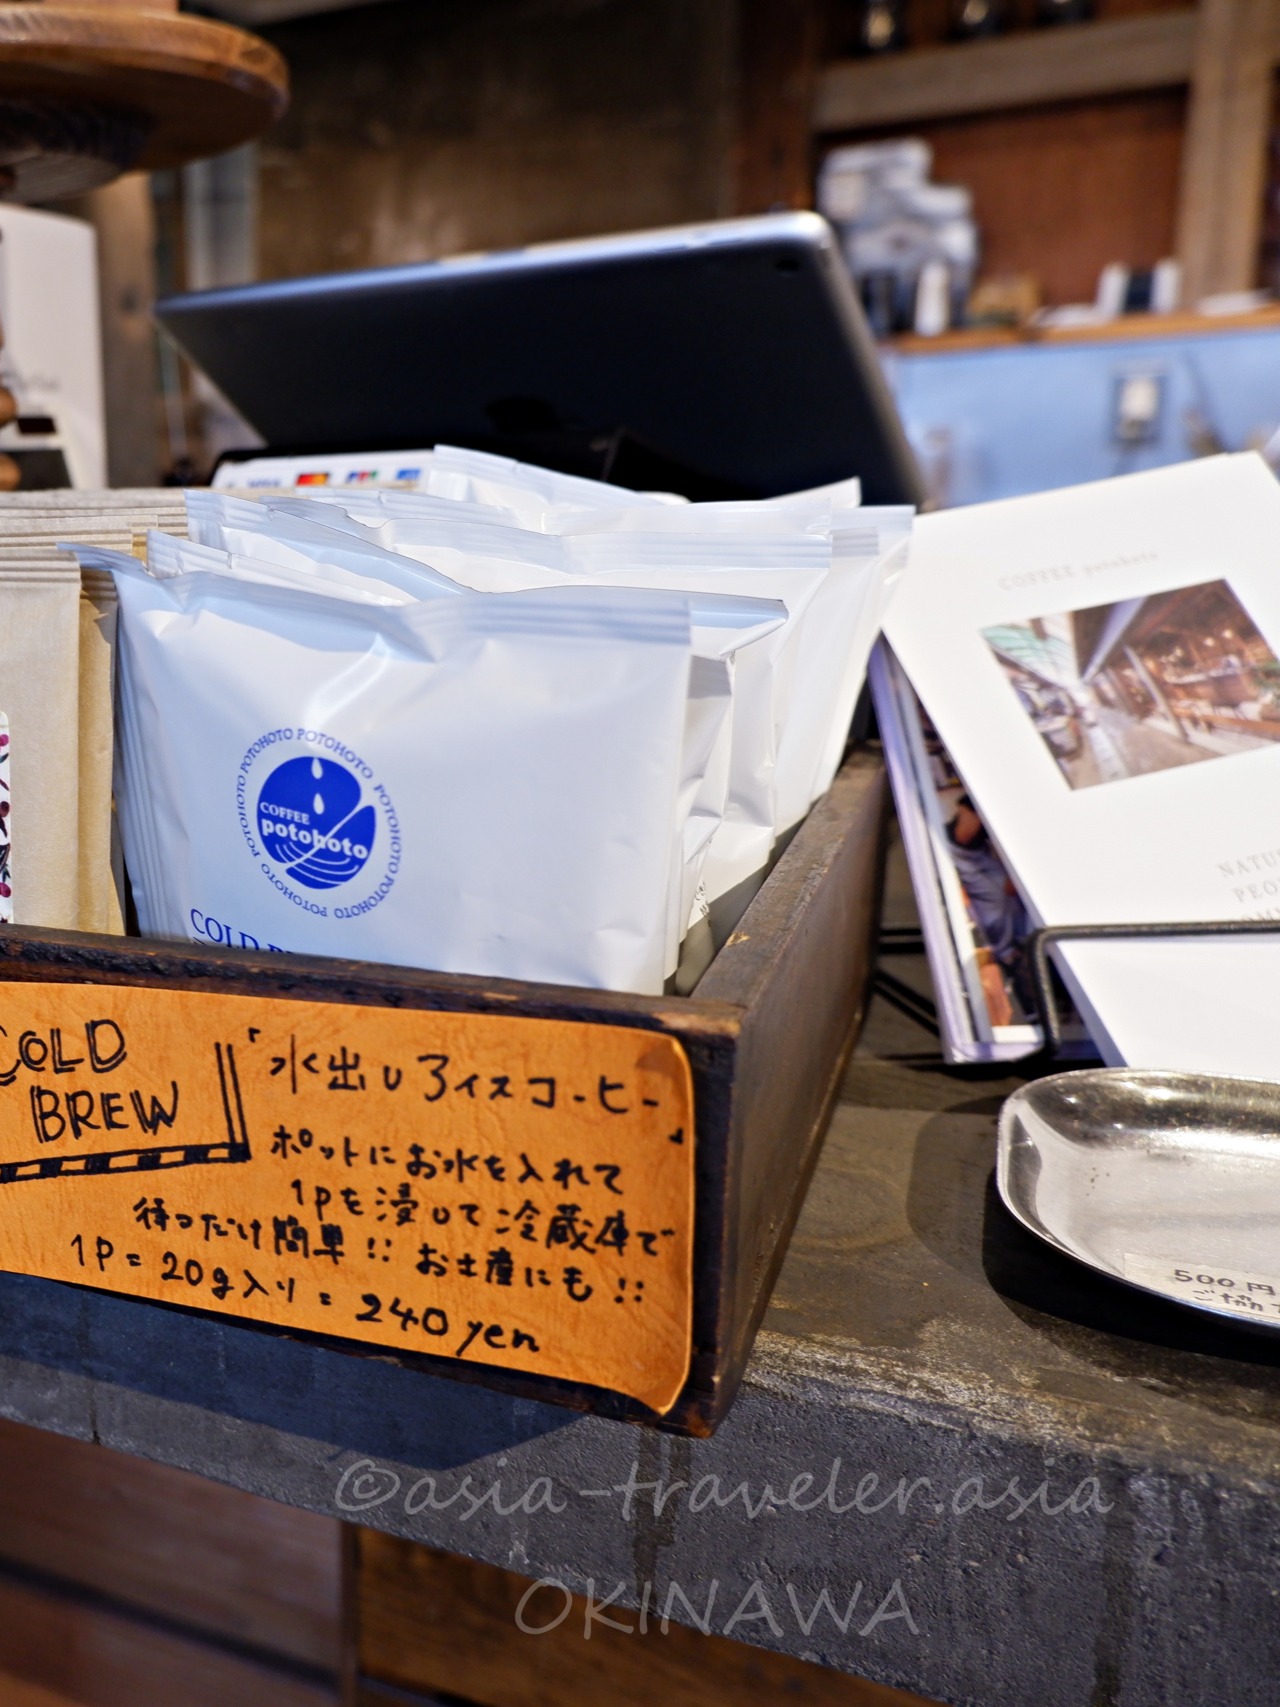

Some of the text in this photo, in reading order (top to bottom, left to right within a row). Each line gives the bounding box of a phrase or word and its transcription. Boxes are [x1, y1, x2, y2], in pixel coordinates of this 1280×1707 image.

[240, 728, 294, 775] POTOHOTO
[296, 728, 373, 779] POTOHOTO
[260, 802, 310, 825] COFFEE
[261, 818, 368, 859] potohoto
[1216, 849, 1280, 879] NATU
[1231, 876, 1280, 903] PEO
[30, 1080, 179, 1144] BREW
[271, 1126, 624, 1195] ポットにお水を入れて
[1174, 1269, 1276, 1297] 500円
[356, 1293, 449, 1336] 240
[456, 1318, 541, 1356] yen
